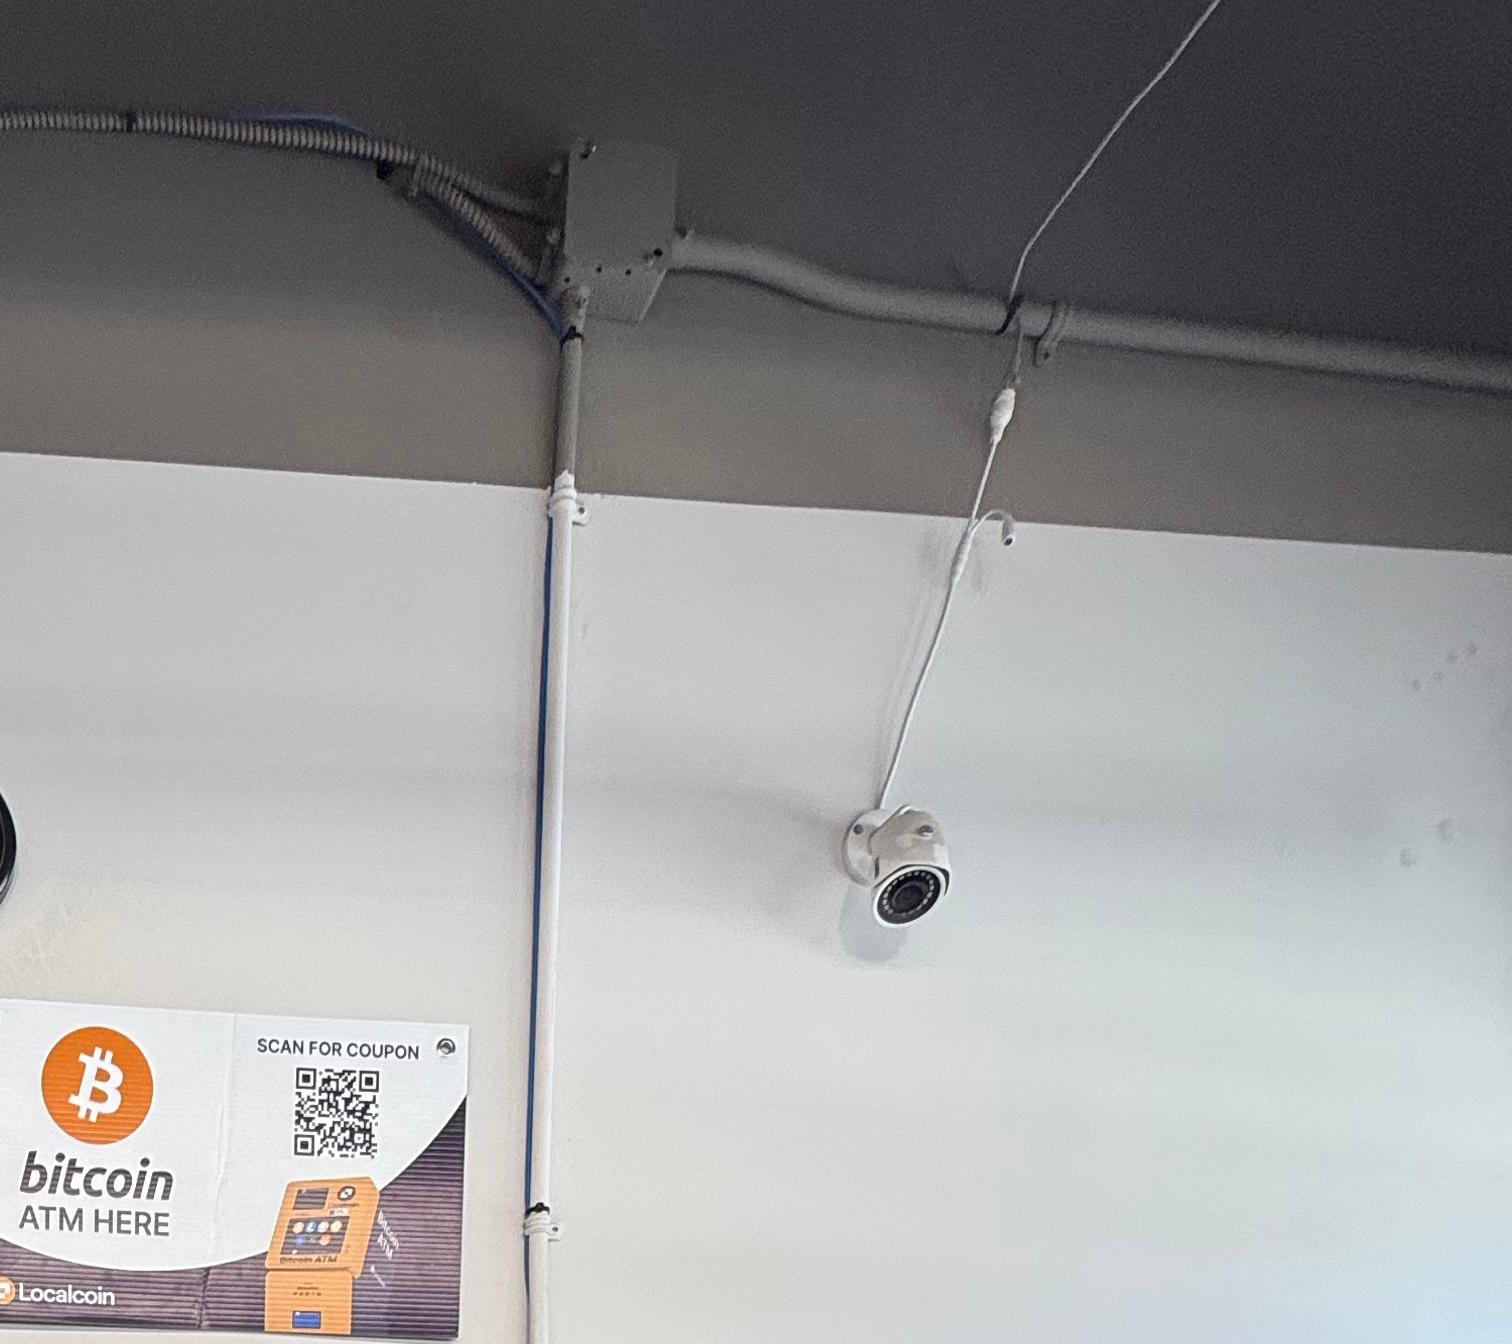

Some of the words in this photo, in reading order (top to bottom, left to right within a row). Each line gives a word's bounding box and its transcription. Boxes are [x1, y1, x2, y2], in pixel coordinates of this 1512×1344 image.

[257, 1038, 304, 1055] SCAN
[310, 1041, 341, 1057] FOR
[347, 1042, 419, 1060] COUPON
[19, 1151, 174, 1201] bitcoin
[19, 1206, 84, 1232] ATM
[94, 1209, 170, 1237] HERE
[19, 1282, 115, 1305] Localcoin
